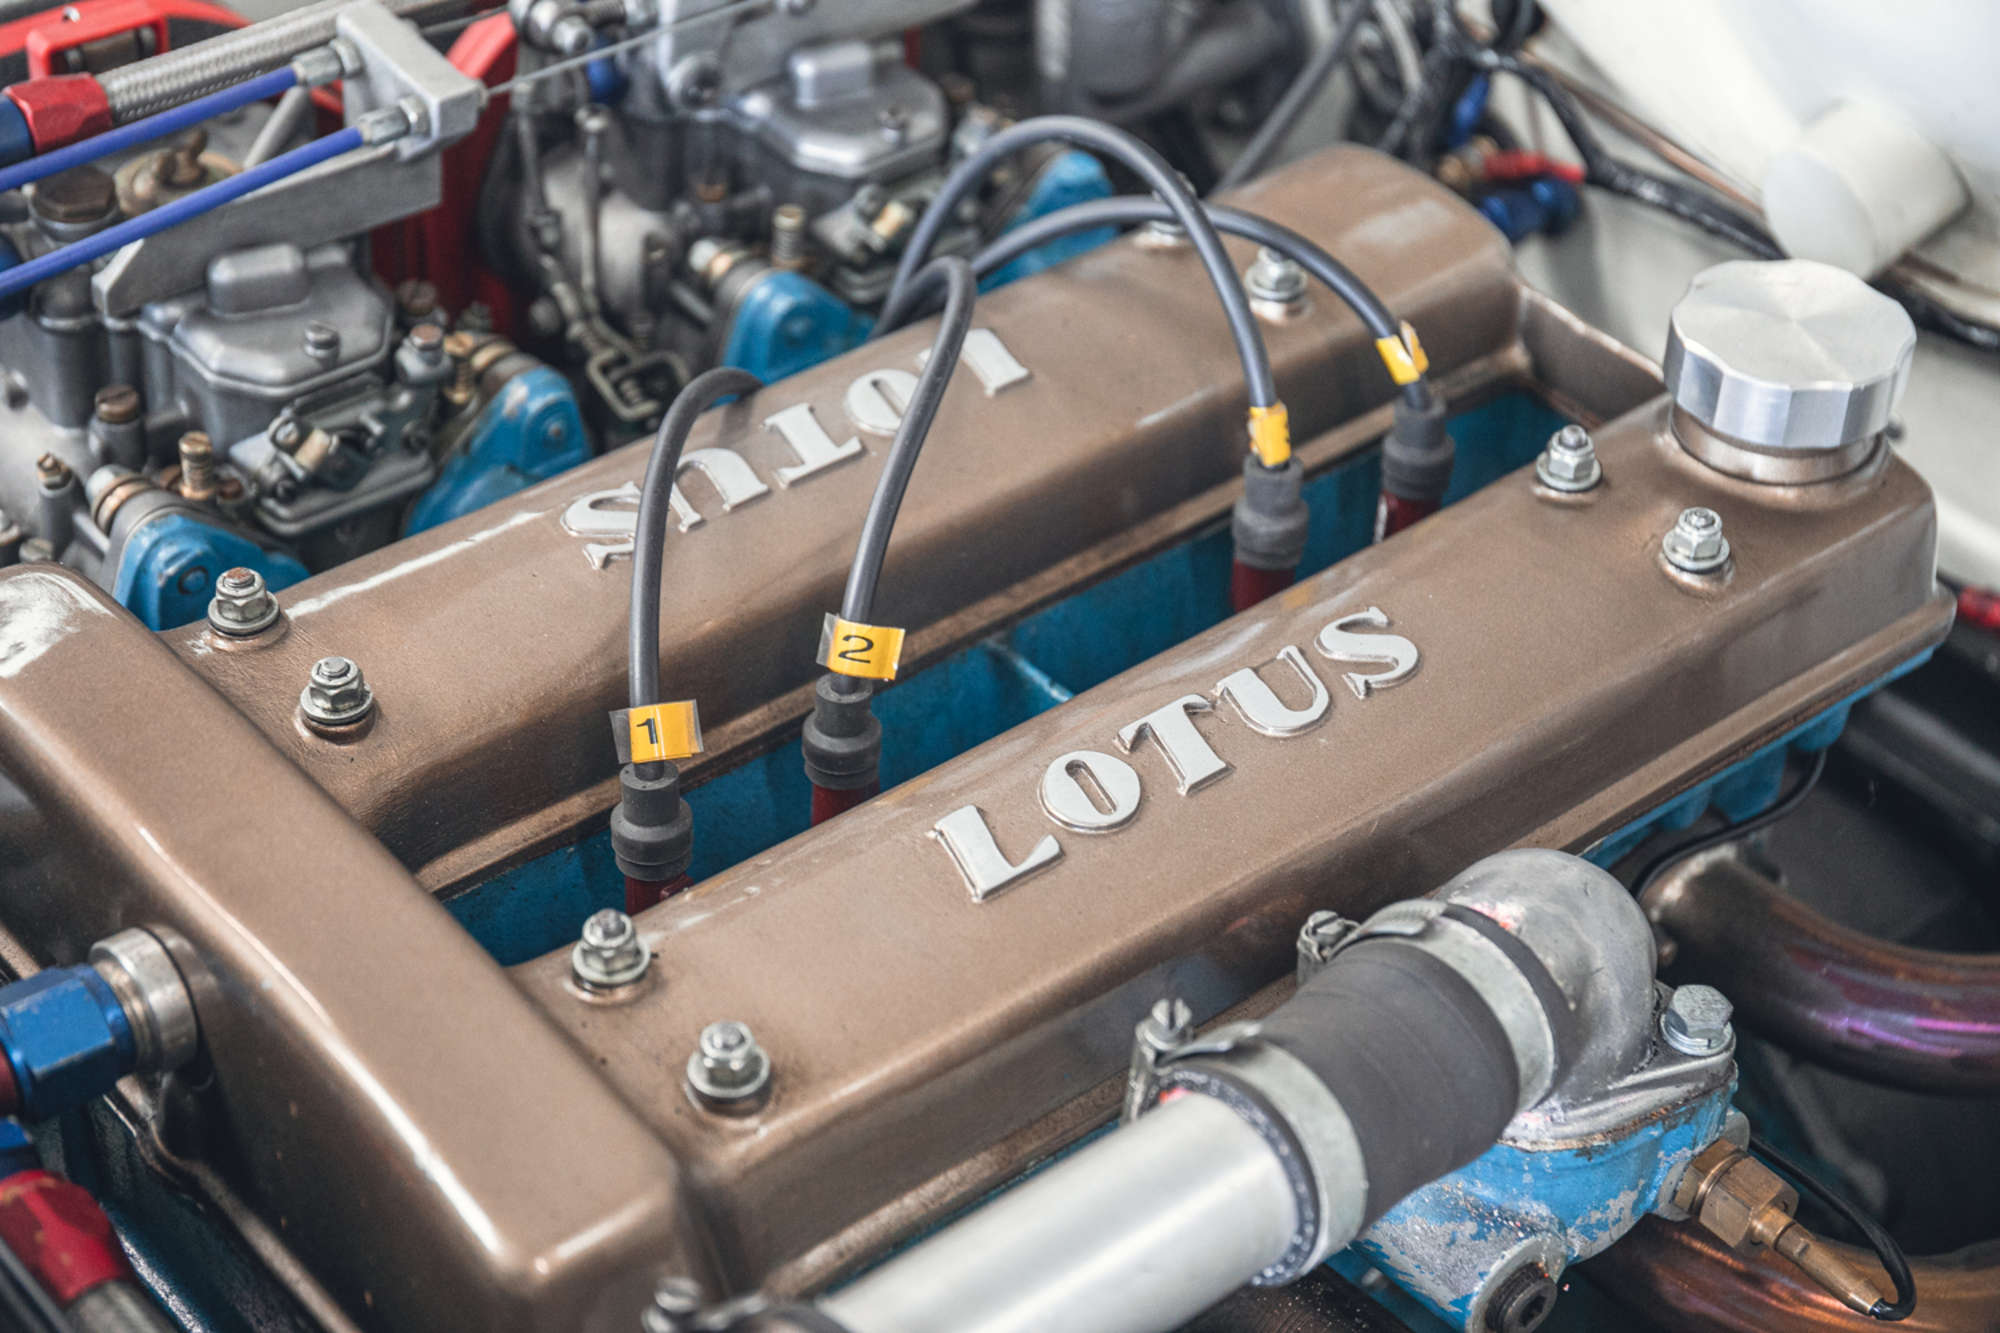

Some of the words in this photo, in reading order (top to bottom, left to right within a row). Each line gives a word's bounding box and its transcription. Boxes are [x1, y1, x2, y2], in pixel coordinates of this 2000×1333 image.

[838, 634, 874, 664] 2
[636, 718, 658, 745] 1
[926, 606, 1421, 902] LOTUS
